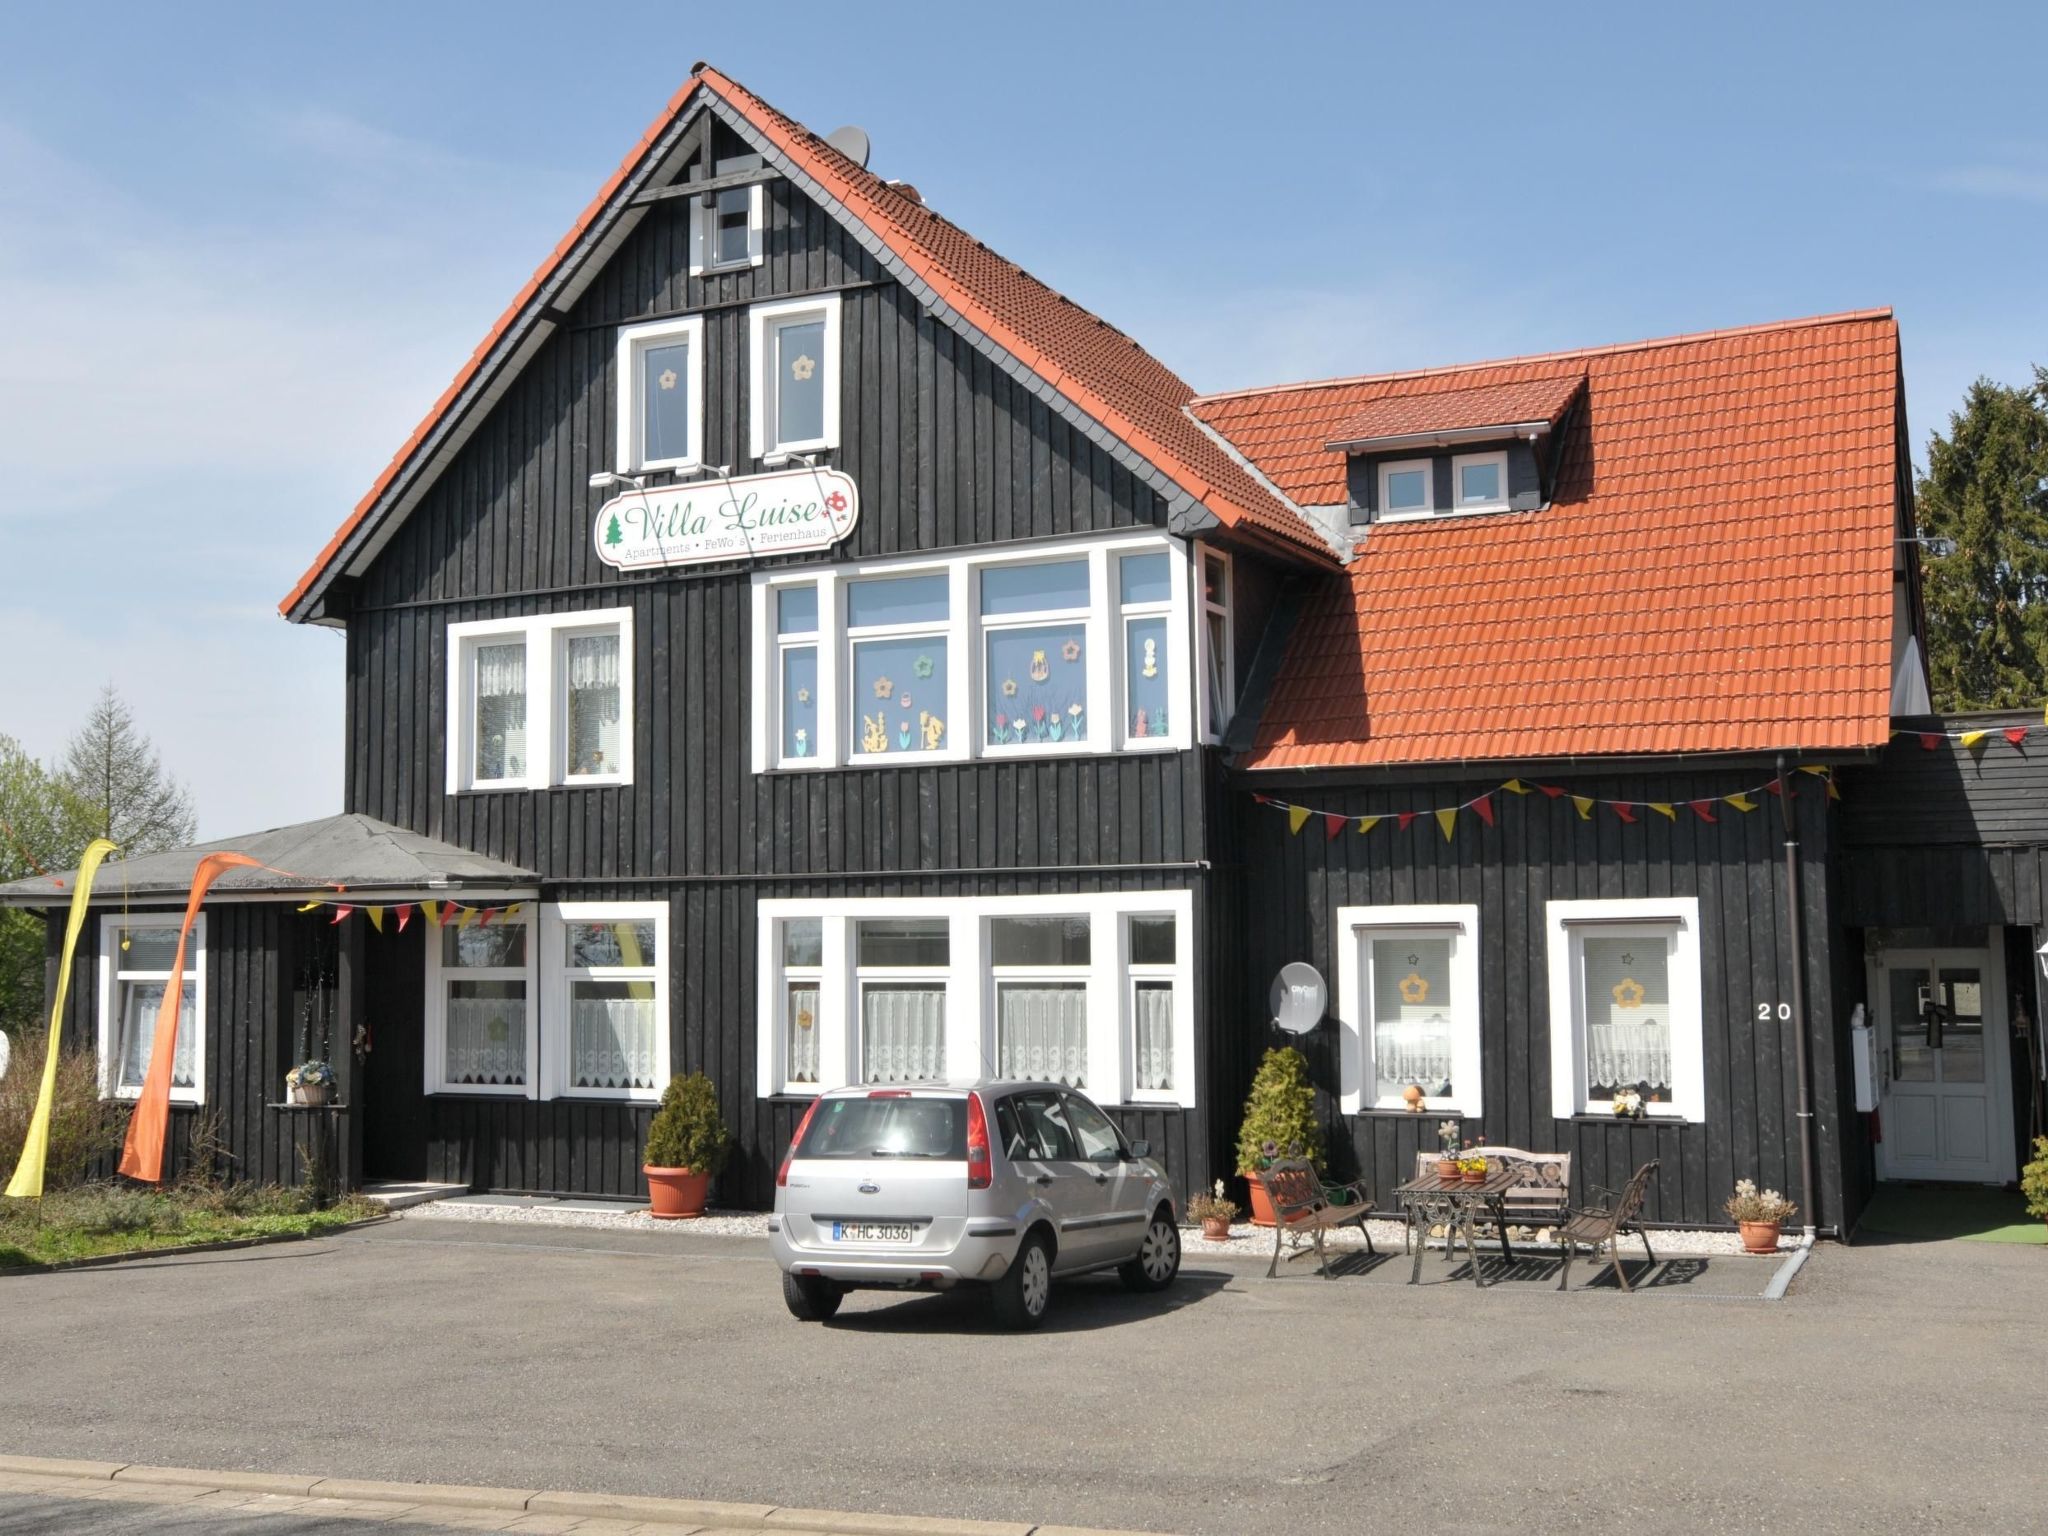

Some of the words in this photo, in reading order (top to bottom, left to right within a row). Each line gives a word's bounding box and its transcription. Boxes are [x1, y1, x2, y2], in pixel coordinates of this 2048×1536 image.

[625, 501, 711, 541] Villa
[719, 492, 822, 530] Luise
[625, 543, 690, 560] Apartments
[760, 528, 826, 543] Ferienhaus
[1758, 1002, 1791, 1020] 20
[876, 1225, 910, 1240] 3036
